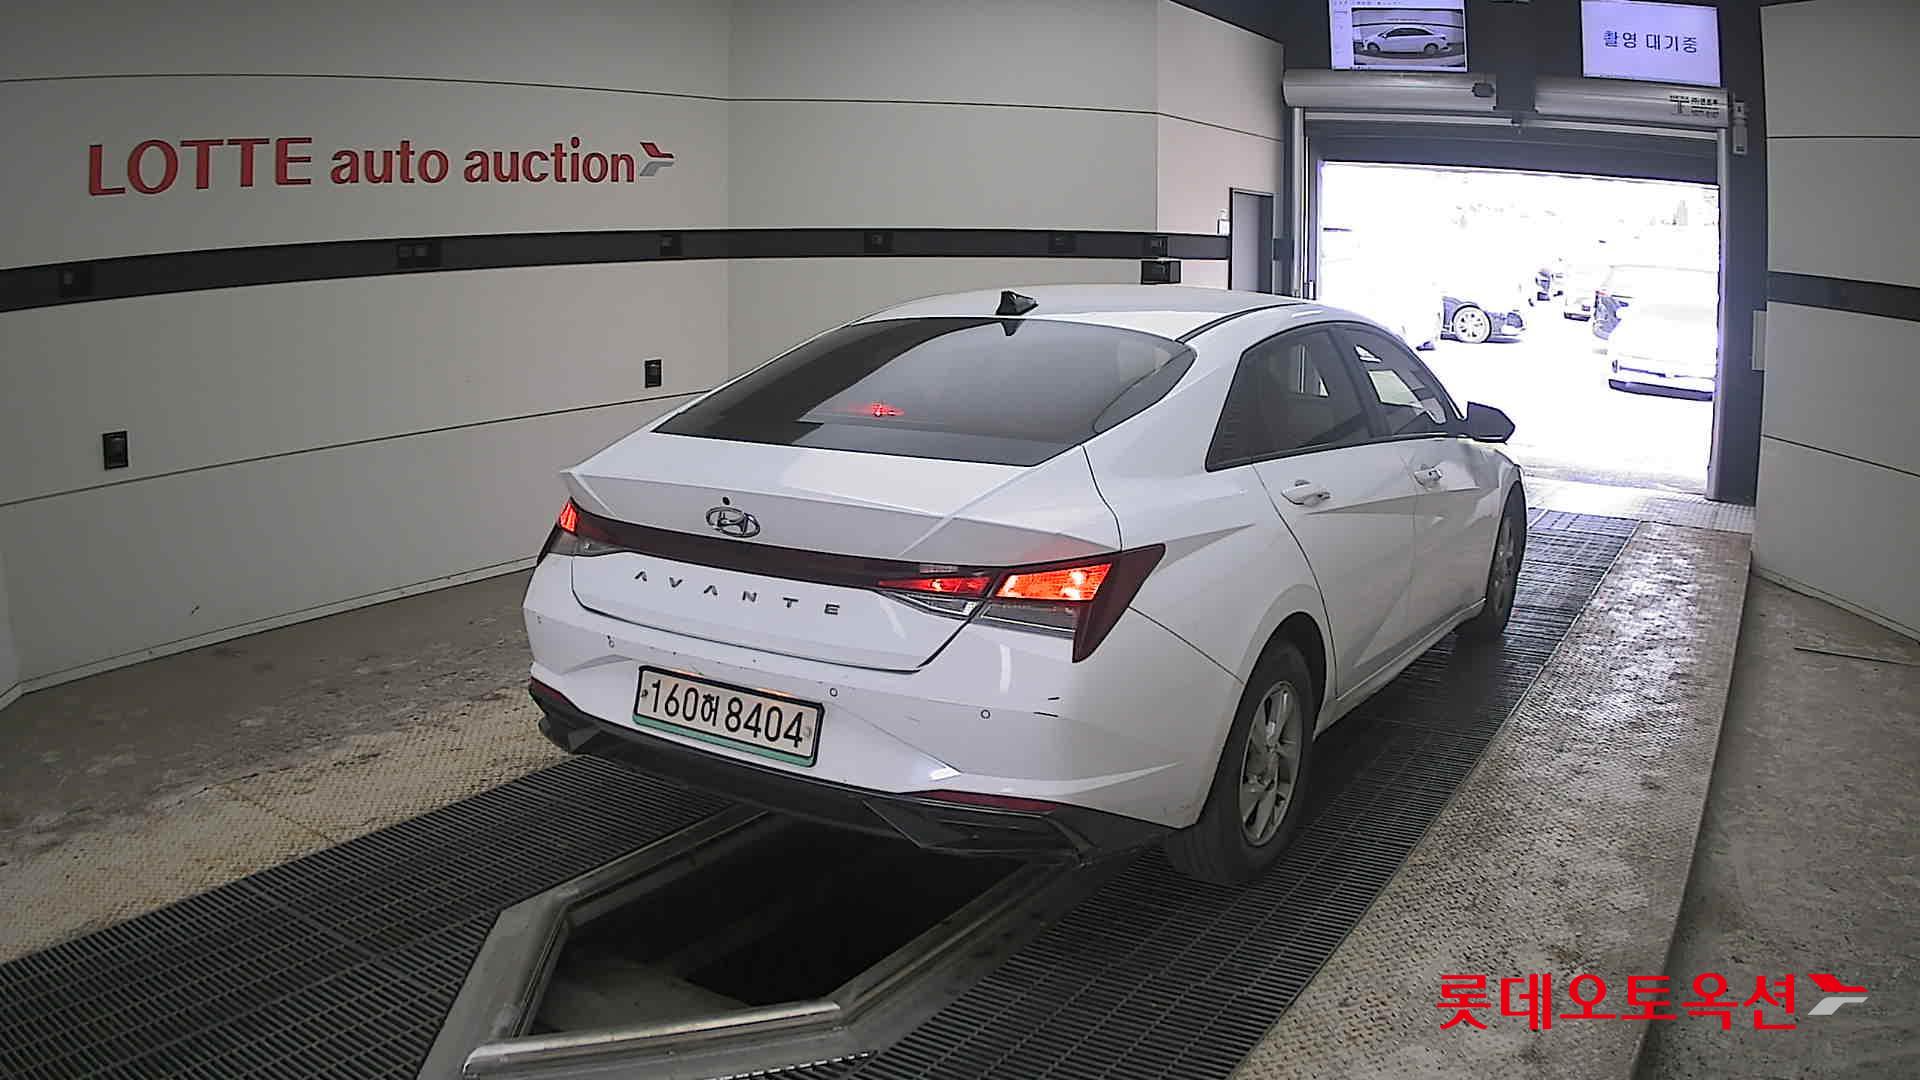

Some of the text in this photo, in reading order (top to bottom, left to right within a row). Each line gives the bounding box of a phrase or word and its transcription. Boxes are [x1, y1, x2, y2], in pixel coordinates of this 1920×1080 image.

[1645, 32, 1697, 54] 대기중
[88, 136, 636, 196] LOTTE auto auction
[634, 570, 841, 616] AVANTE
